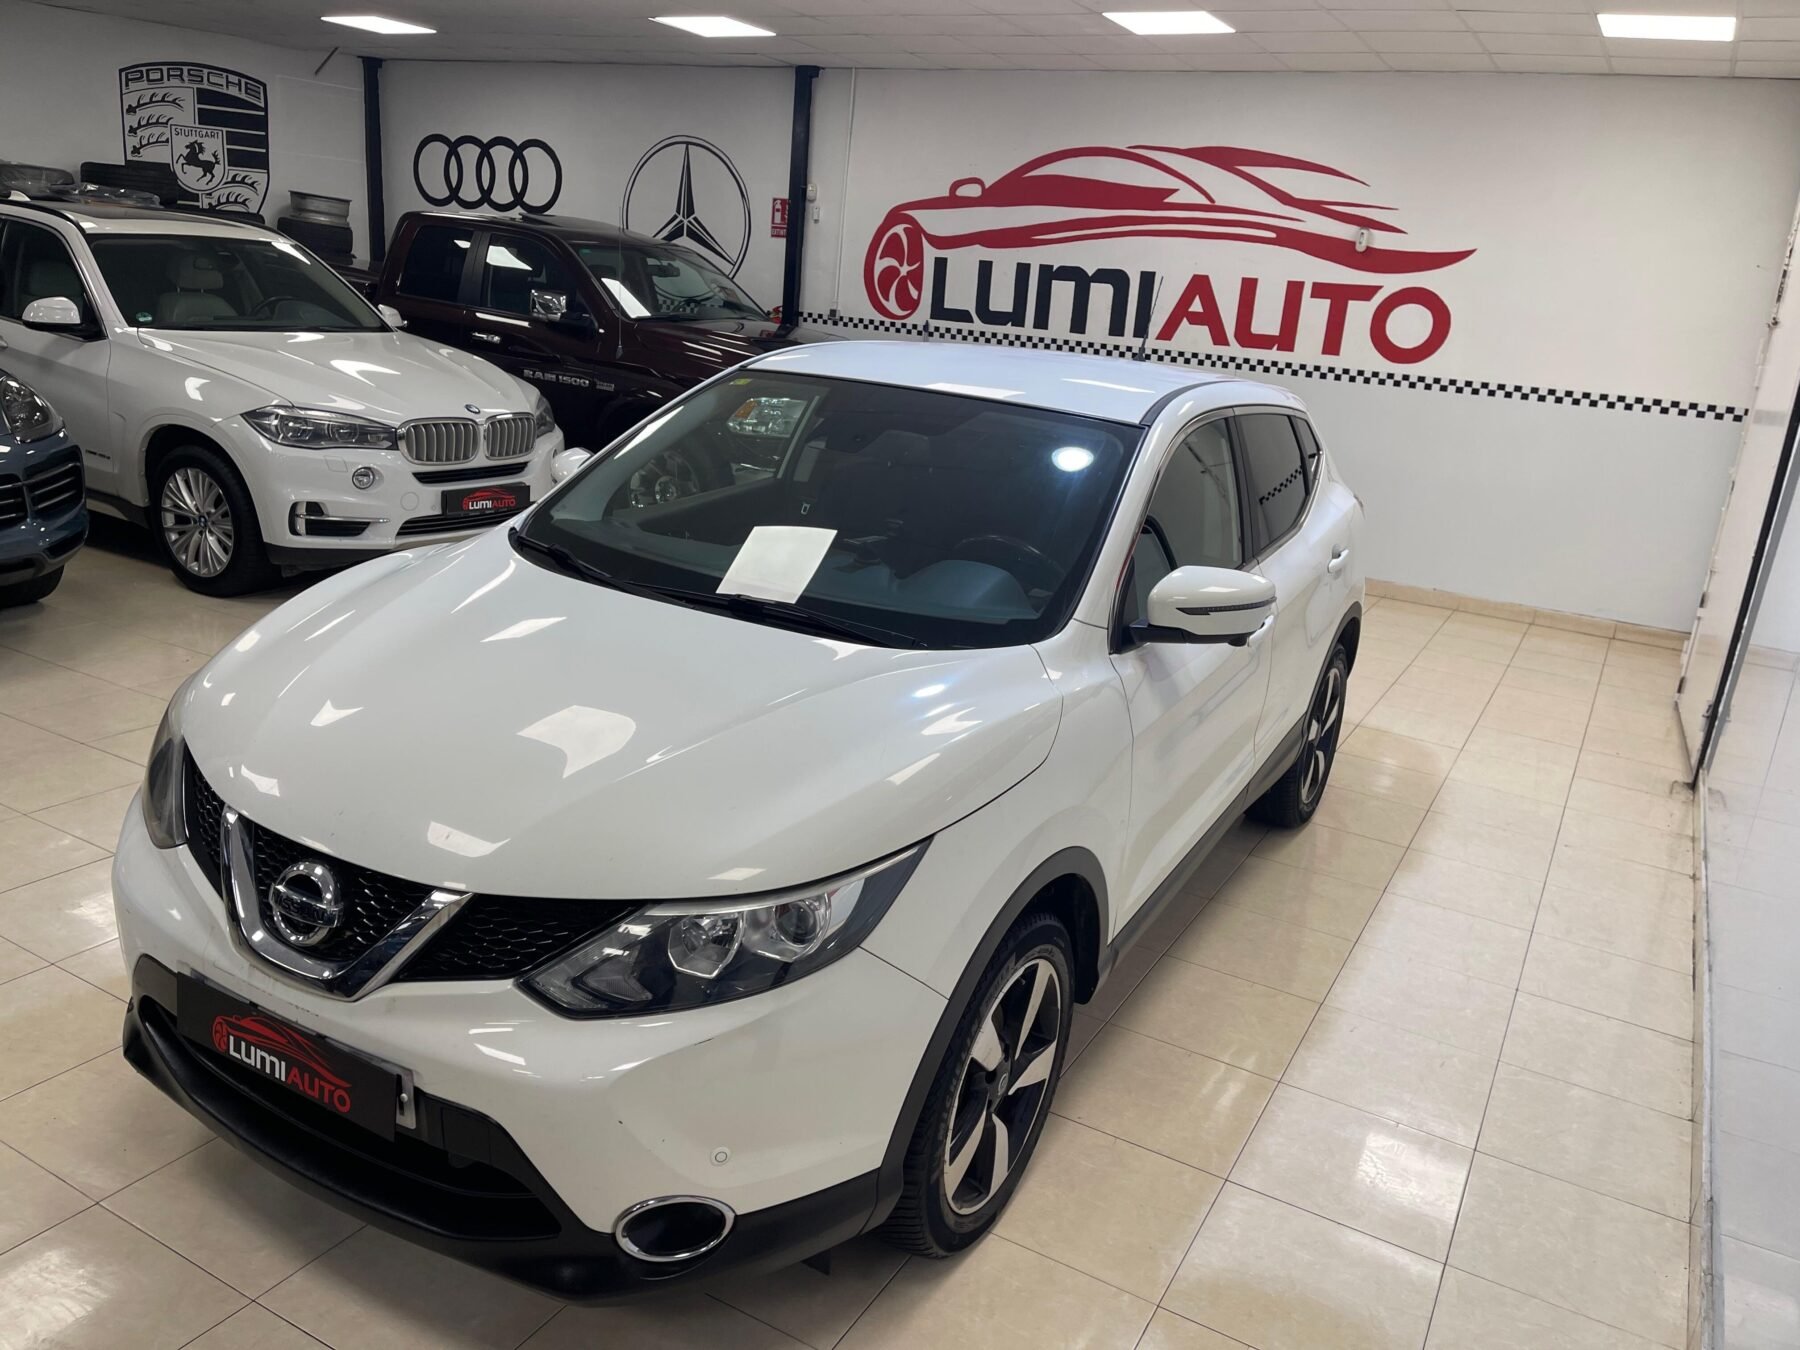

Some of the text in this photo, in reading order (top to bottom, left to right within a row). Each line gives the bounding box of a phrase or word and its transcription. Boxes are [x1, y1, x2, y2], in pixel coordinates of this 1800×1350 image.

[124, 67, 262, 101] PORSCHE
[174, 128, 219, 140] STUTTGART
[523, 369, 556, 382] RAM
[559, 375, 590, 388] 1500
